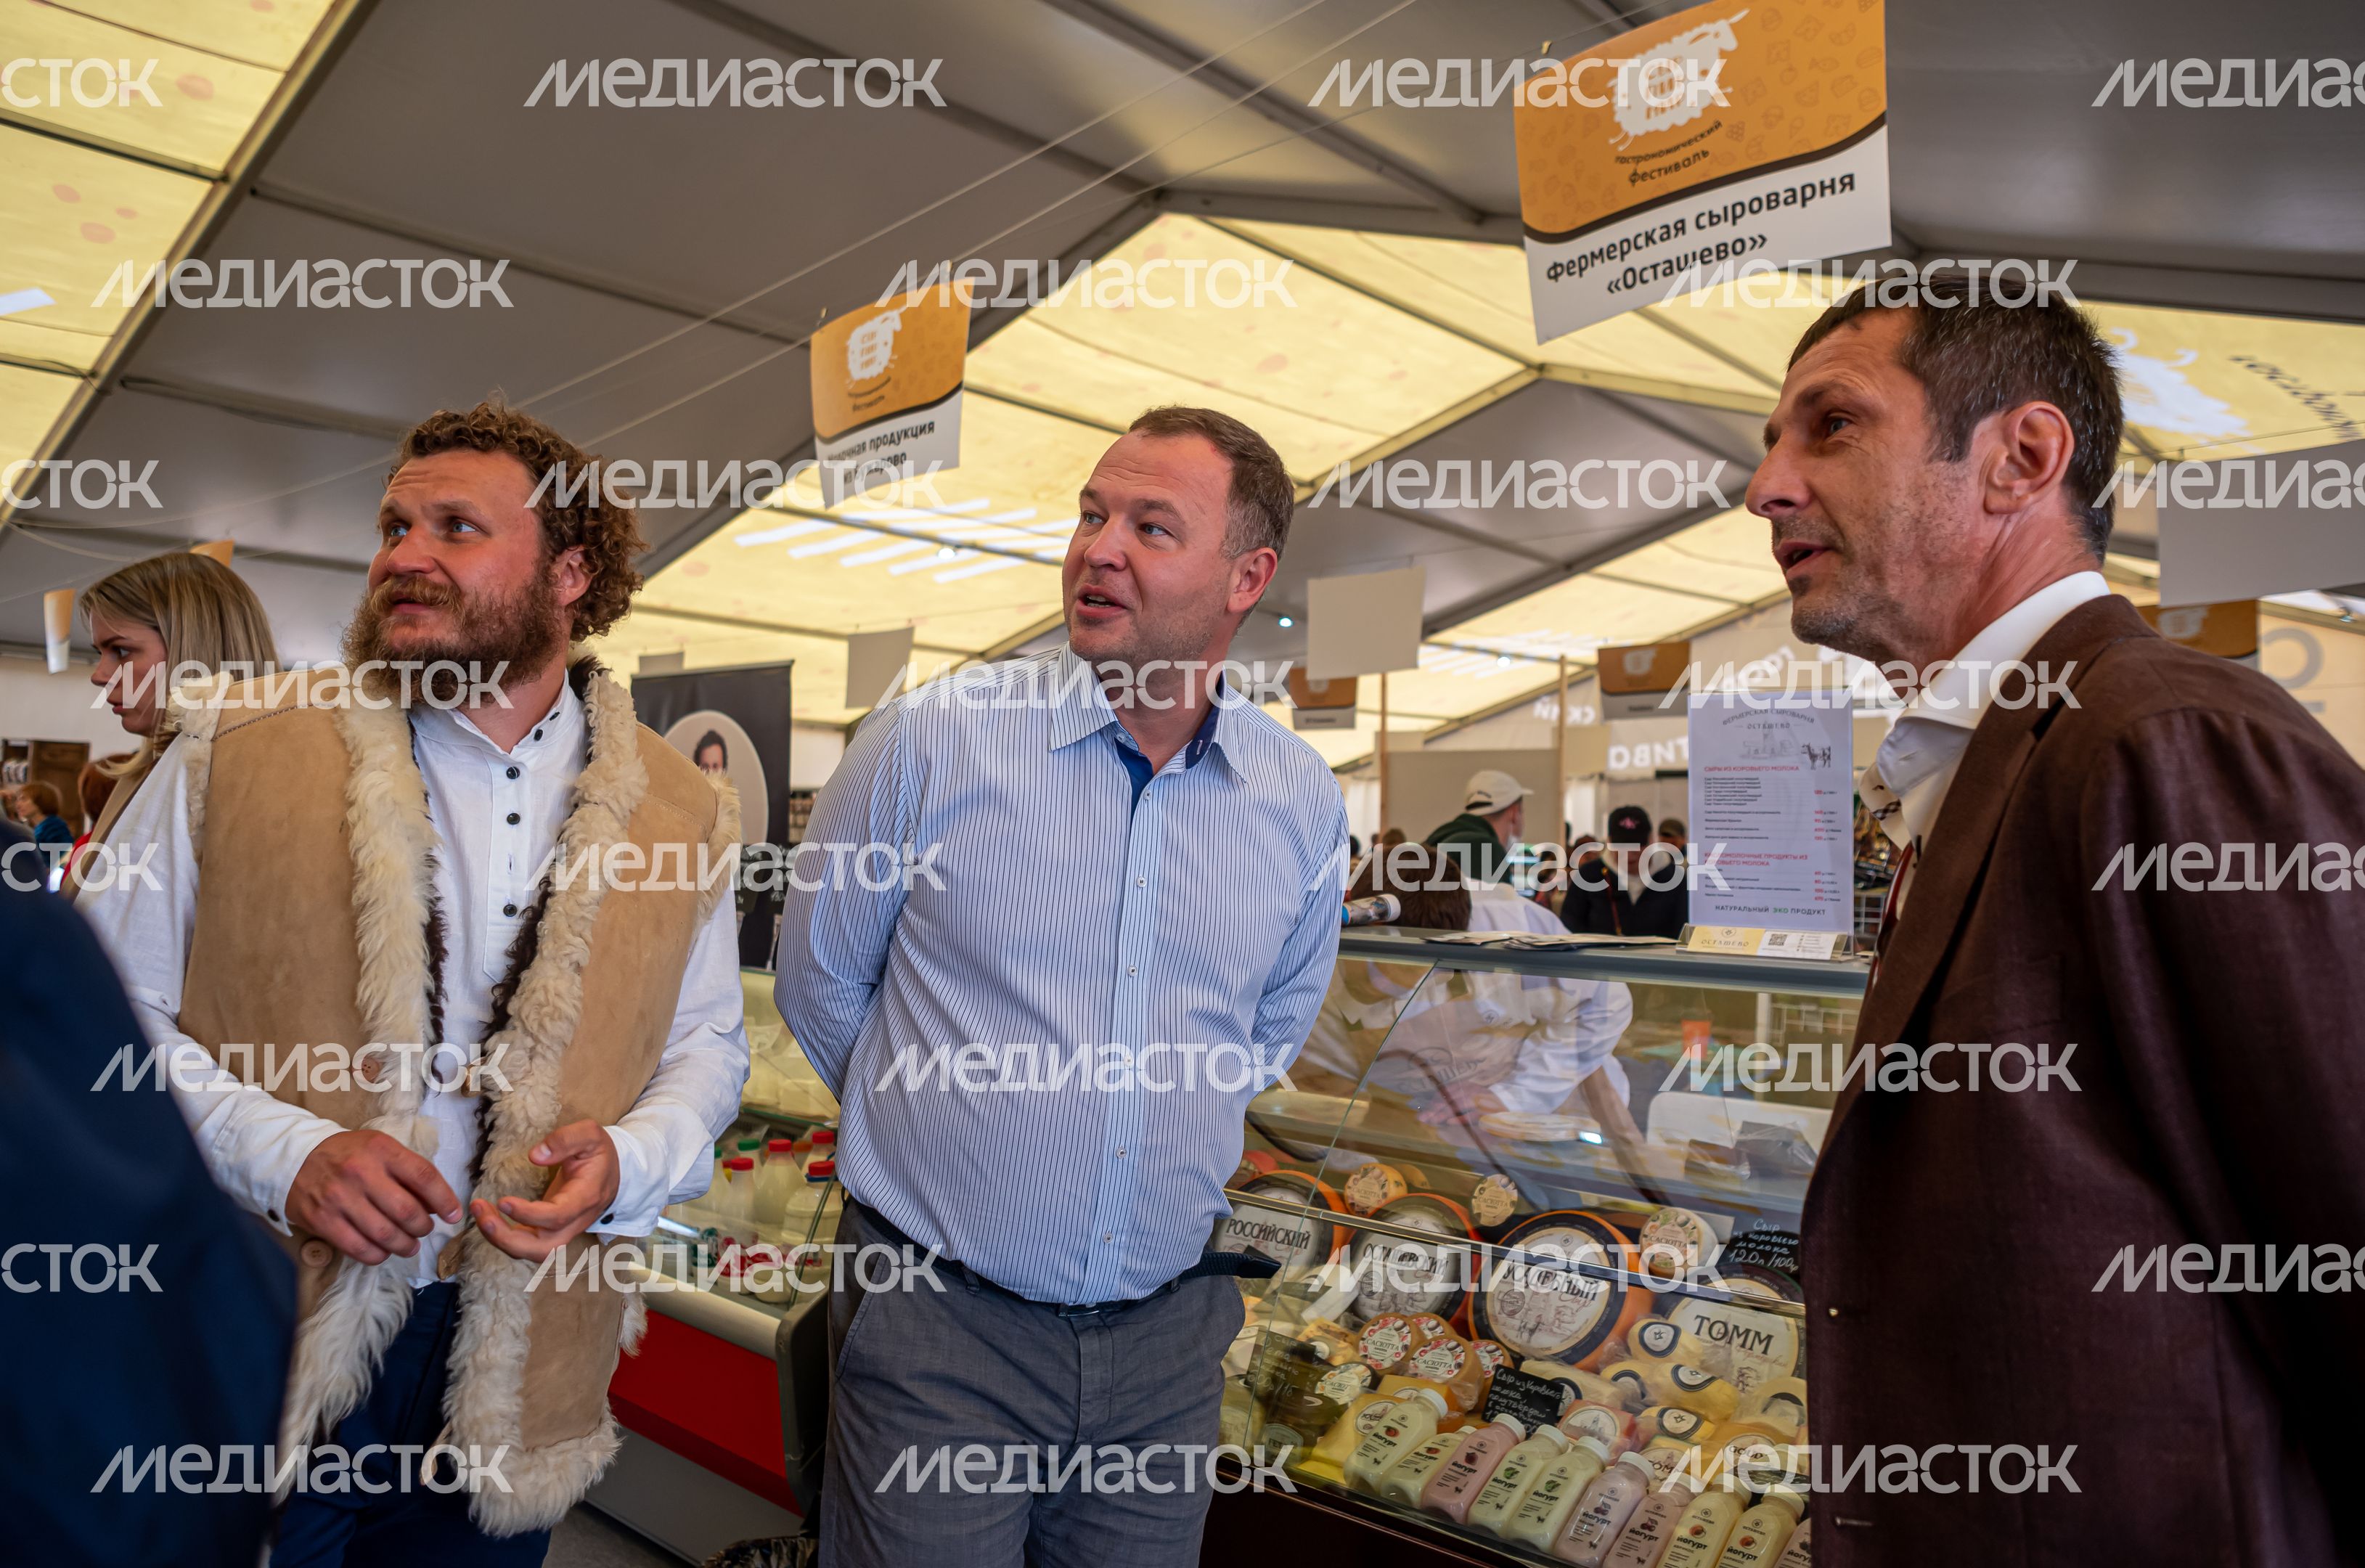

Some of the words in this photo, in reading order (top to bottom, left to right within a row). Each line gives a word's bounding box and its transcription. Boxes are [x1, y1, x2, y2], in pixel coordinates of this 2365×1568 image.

[1628, 150, 1710, 187] фестиваль
[1695, 172, 1855, 229] сыроварня
[1607, 234, 1768, 294] «Осташево»
[869, 420, 935, 452] продукция
[1723, 709, 1769, 725] ФЕРМЕРСКАЯ
[1770, 709, 1815, 724] СЫРОВАРНЯ
[1715, 905, 1770, 913] НАТУРАЛЬНЫЙ
[1226, 1217, 1312, 1250] РОССИЙСКИЙ
[1753, 1218, 1781, 1237] Сыр
[1366, 1338, 1400, 1352] CACIOTTA
[1492, 1477, 1518, 1489] йогурт
[1532, 1490, 1560, 1502] йогурт
[1582, 1511, 1612, 1526] йогурт
[1629, 1527, 1659, 1543] йогурт
[1677, 1535, 1708, 1551] йогурт
[1727, 1546, 1759, 1561] йогурт
